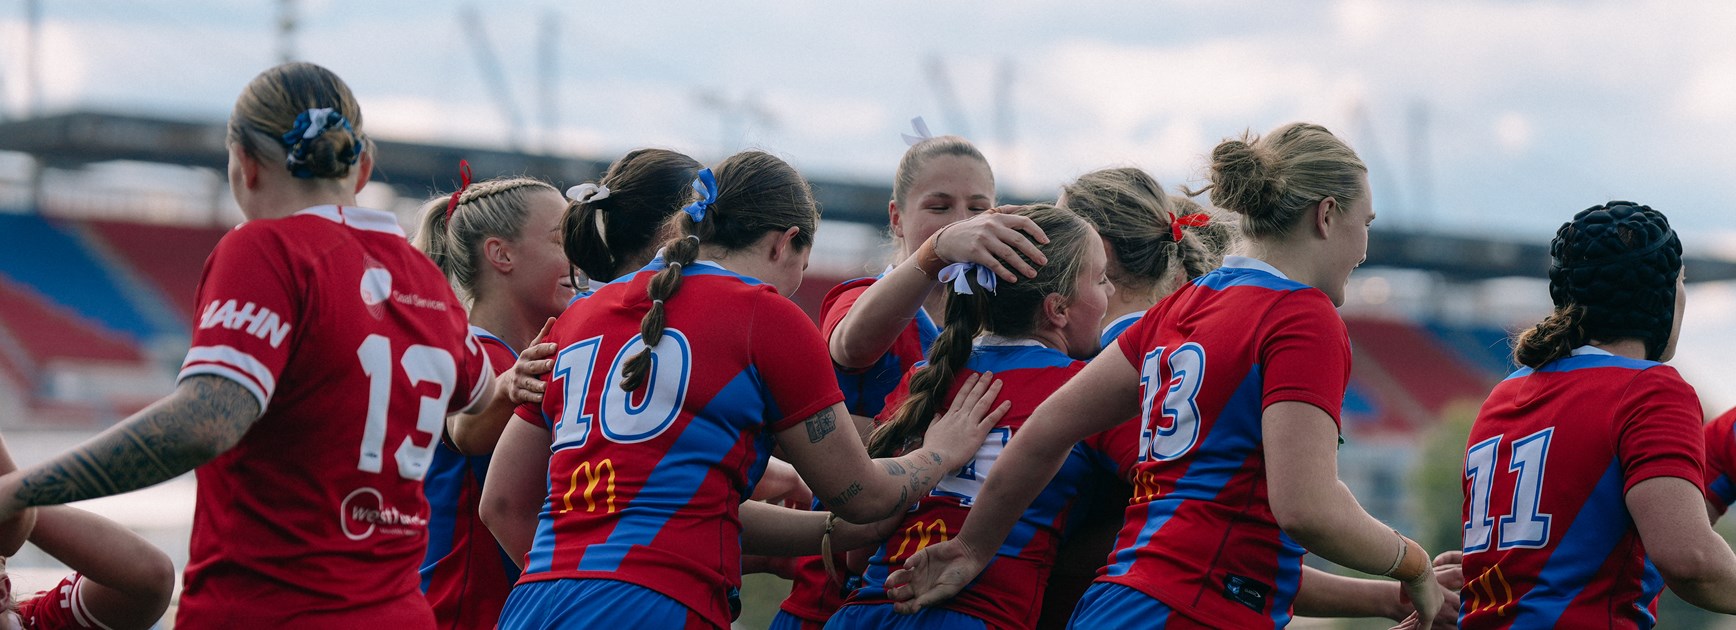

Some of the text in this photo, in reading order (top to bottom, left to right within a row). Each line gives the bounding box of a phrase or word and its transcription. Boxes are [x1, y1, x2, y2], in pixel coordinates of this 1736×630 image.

[357, 334, 457, 481] 13
[550, 327, 692, 454] 10
[1138, 342, 1206, 463] 13
[1463, 427, 1555, 555] 11
